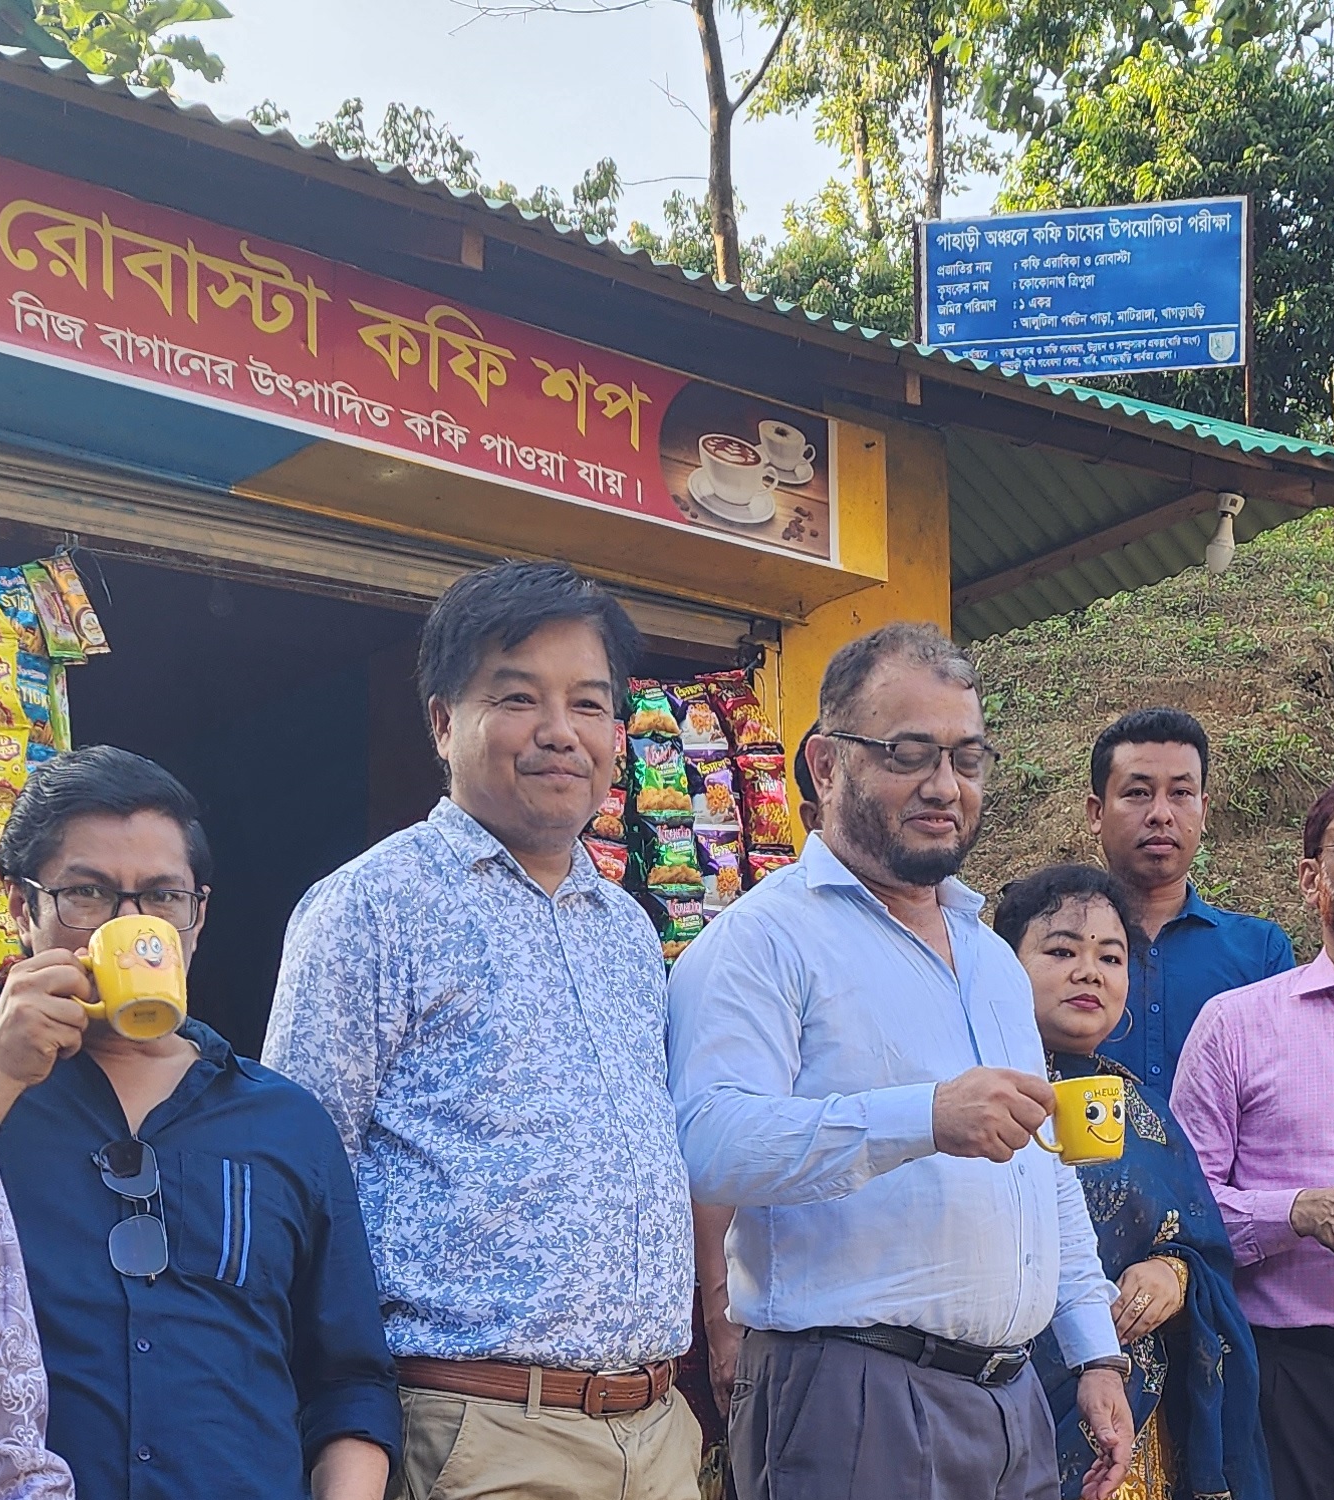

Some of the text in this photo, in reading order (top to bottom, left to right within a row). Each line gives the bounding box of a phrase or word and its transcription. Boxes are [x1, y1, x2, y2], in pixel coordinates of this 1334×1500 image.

[936, 208, 1232, 253] পাহাড়ী অঞ্চলে কফি চাষের উপযোগিতা পরীক্ষা
[936, 260, 973, 278] প্রজাতির
[975, 261, 993, 274] নাম
[1020, 254, 1041, 271] কফি
[1042, 253, 1081, 269] এরাবিকা
[1083, 256, 1092, 267] ও
[936, 282, 970, 301] কৃষকের
[972, 280, 990, 294] নাম
[936, 301, 962, 316] জমির
[964, 297, 997, 314] পরিমাণ
[1028, 296, 1052, 309] একর
[937, 322, 955, 337] স্থান
[7, 290, 88, 349] নিজ
[94, 323, 238, 390] বাগানের
[245, 355, 395, 428] উৎপাদিত
[400, 408, 470, 453] কফি
[479, 432, 568, 483] পাওয়া
[348, 298, 516, 408] কফি
[530, 357, 652, 452] শপ
[1094, 1088, 1120, 1098] HELLO
